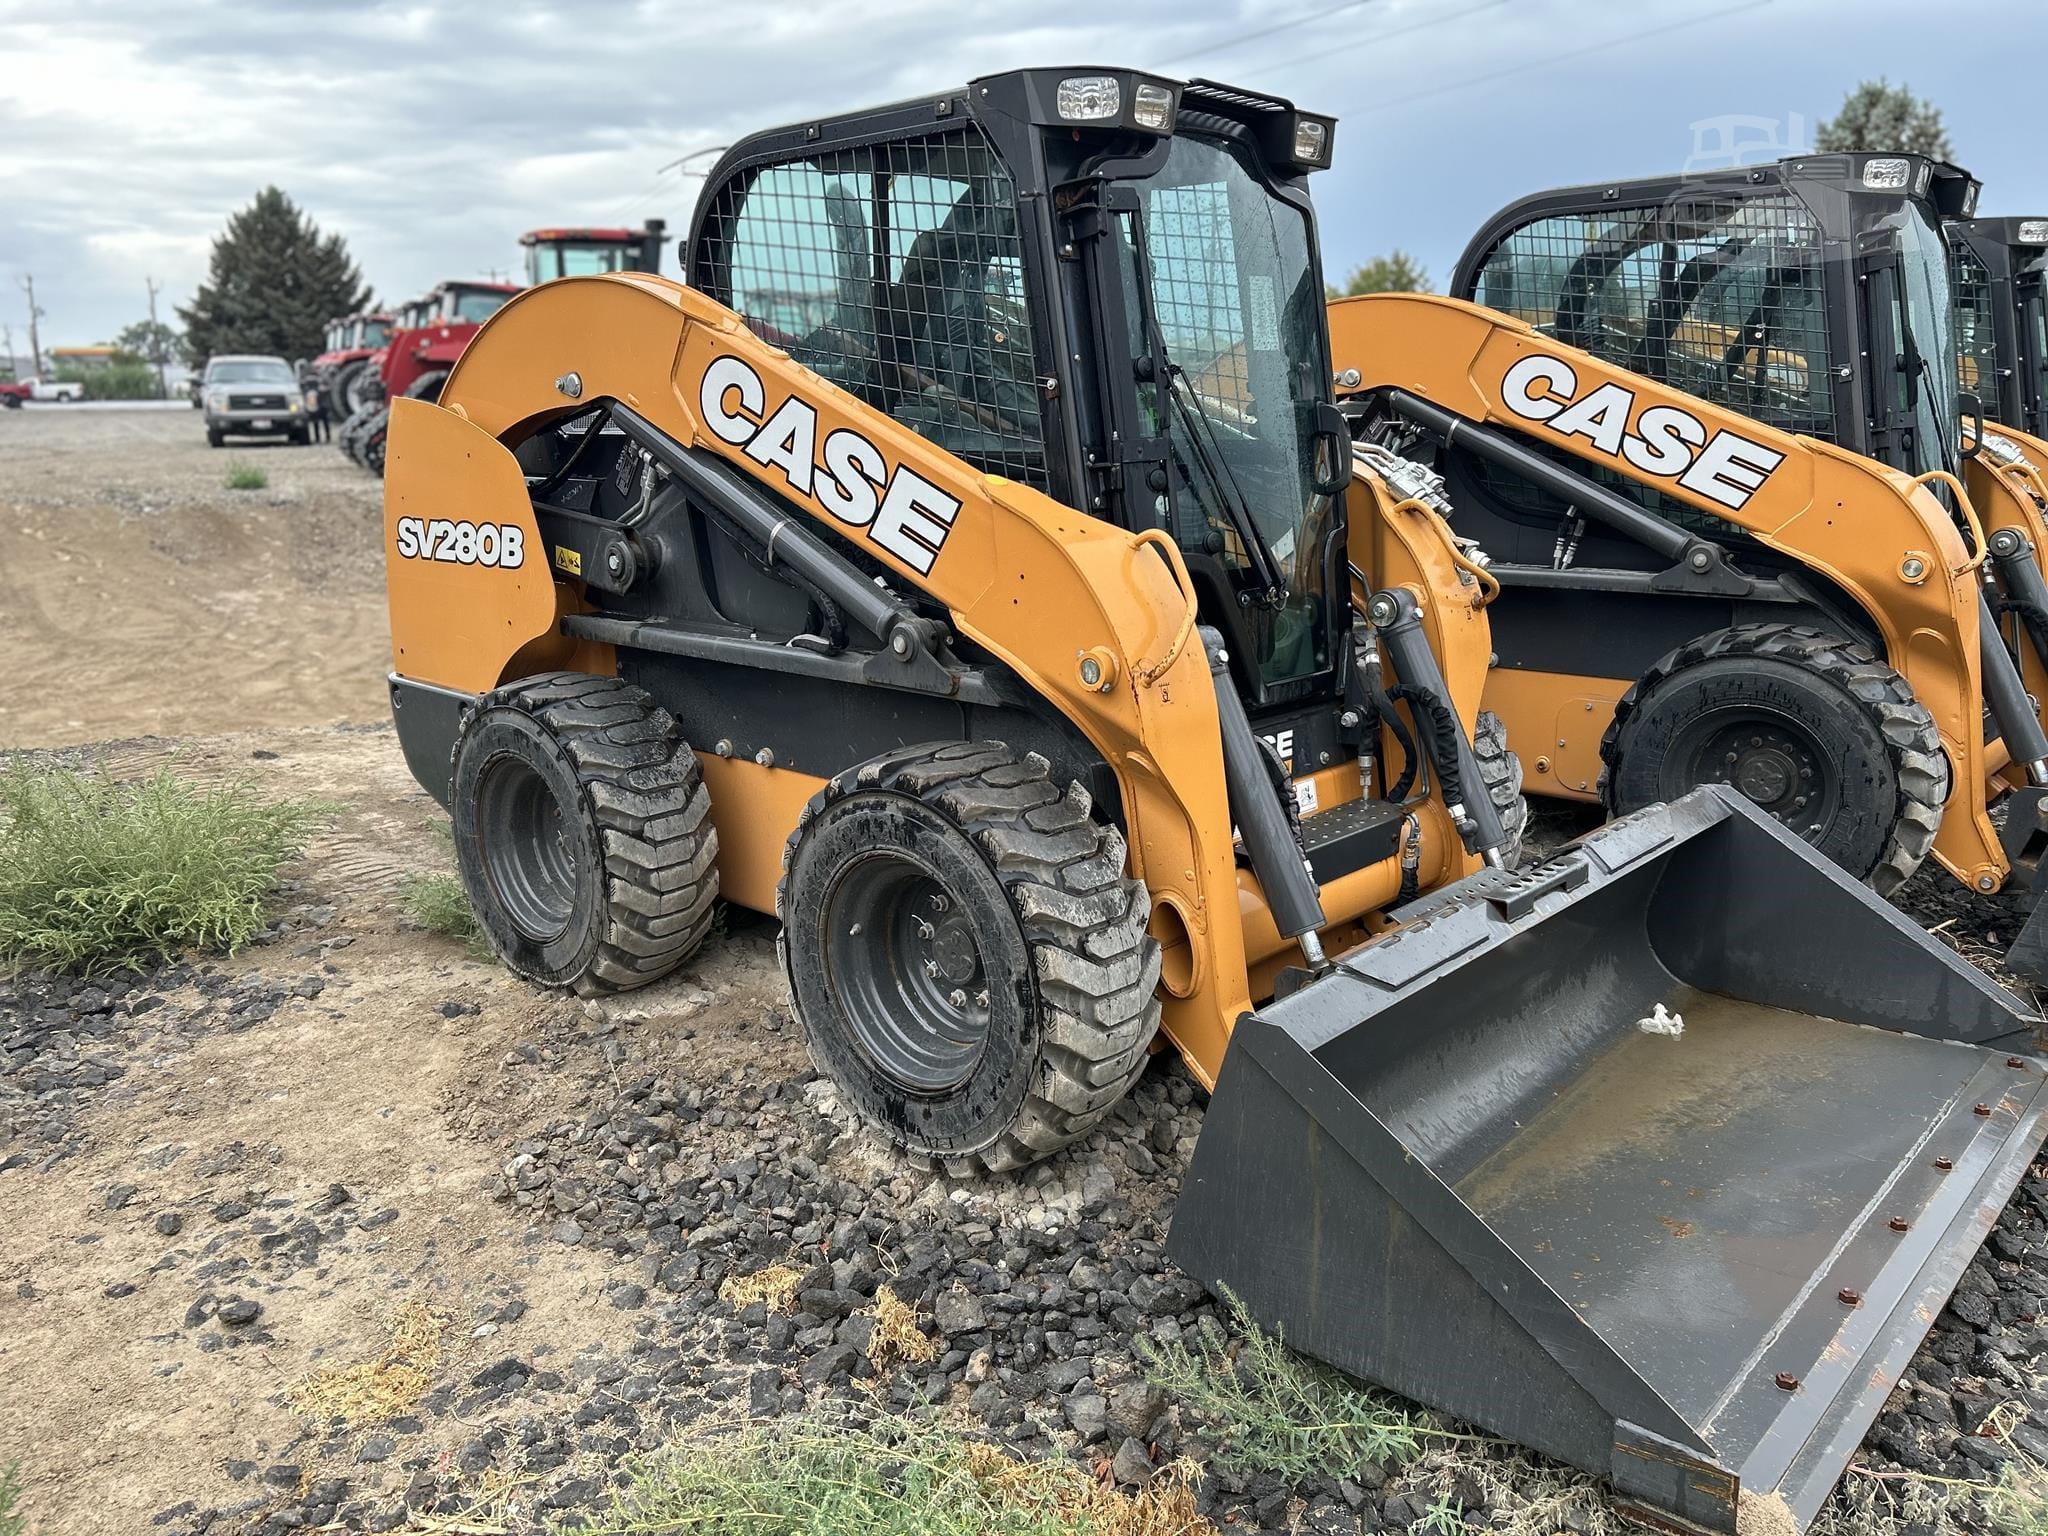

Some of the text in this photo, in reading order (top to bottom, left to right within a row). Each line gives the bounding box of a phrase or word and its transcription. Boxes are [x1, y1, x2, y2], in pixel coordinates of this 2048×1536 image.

[700, 354, 964, 578] CASE
[1500, 354, 1787, 512] CASE
[397, 516, 524, 569] SV280B
